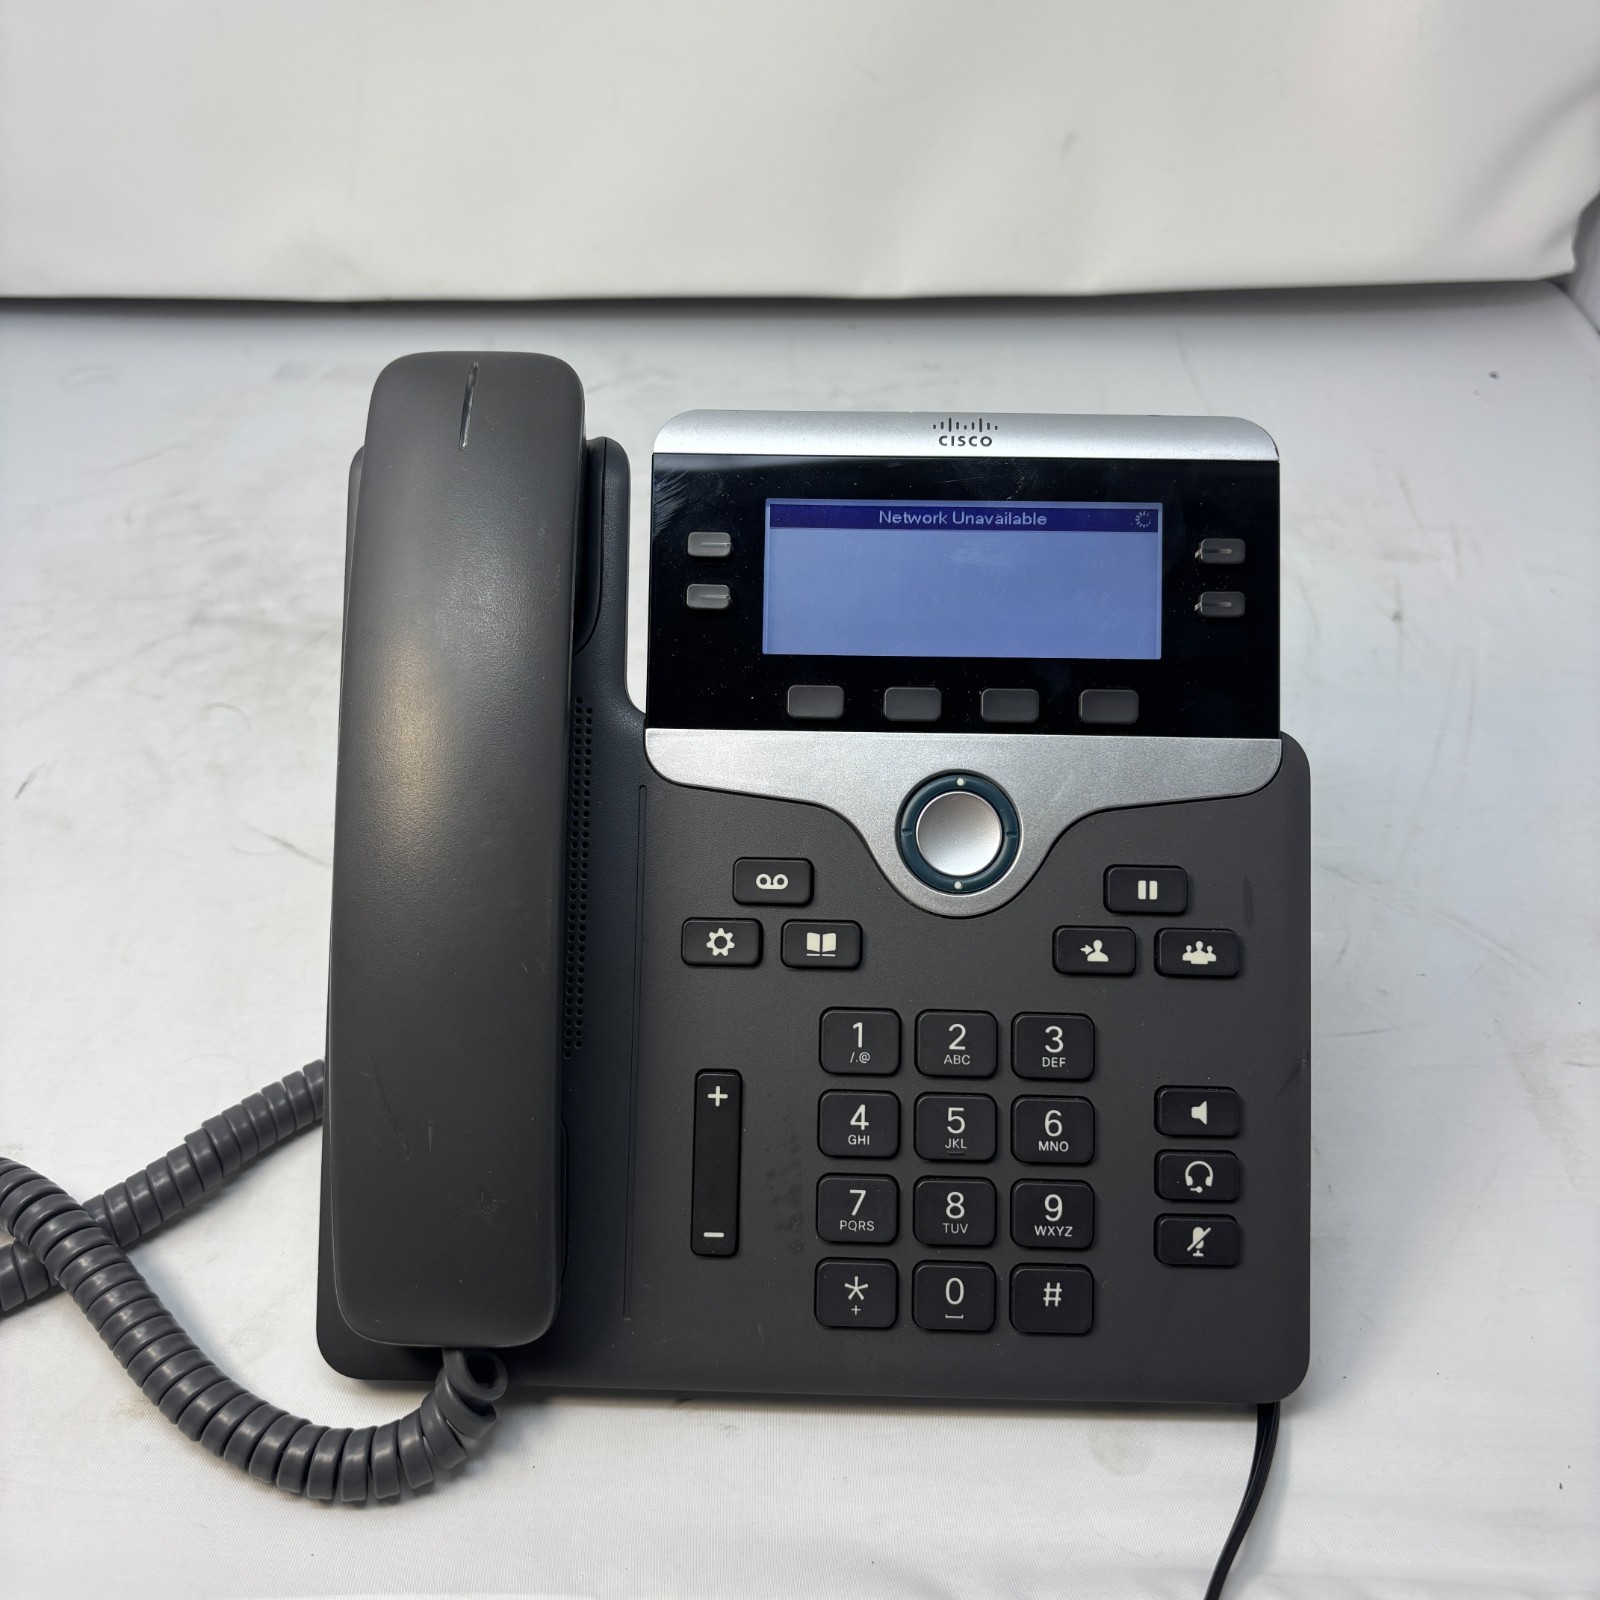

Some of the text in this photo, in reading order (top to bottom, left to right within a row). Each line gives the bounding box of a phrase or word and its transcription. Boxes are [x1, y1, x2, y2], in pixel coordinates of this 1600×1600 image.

[938, 435, 993, 447] CISCO
[878, 510, 1048, 526] Network Unavailable
[852, 1022, 863, 1048] 1
[948, 1024, 966, 1051] 2
[1044, 1026, 1064, 1053] 3
[943, 1054, 971, 1065] ABC
[1042, 1057, 1066, 1068] DEF
[850, 1104, 870, 1131] 4
[946, 1107, 966, 1134] 5
[1044, 1110, 1063, 1137] 6
[848, 1135, 870, 1145] GHI
[944, 1138, 967, 1149] JKL
[1038, 1141, 1069, 1152] MNO
[849, 1189, 867, 1216] 7
[945, 1192, 965, 1219] 8
[1044, 1194, 1063, 1222] 9
[839, 1220, 875, 1232] PQRS
[942, 1223, 968, 1234] TUV
[1034, 1225, 1073, 1237] WXYZ
[945, 1278, 965, 1305] 0
